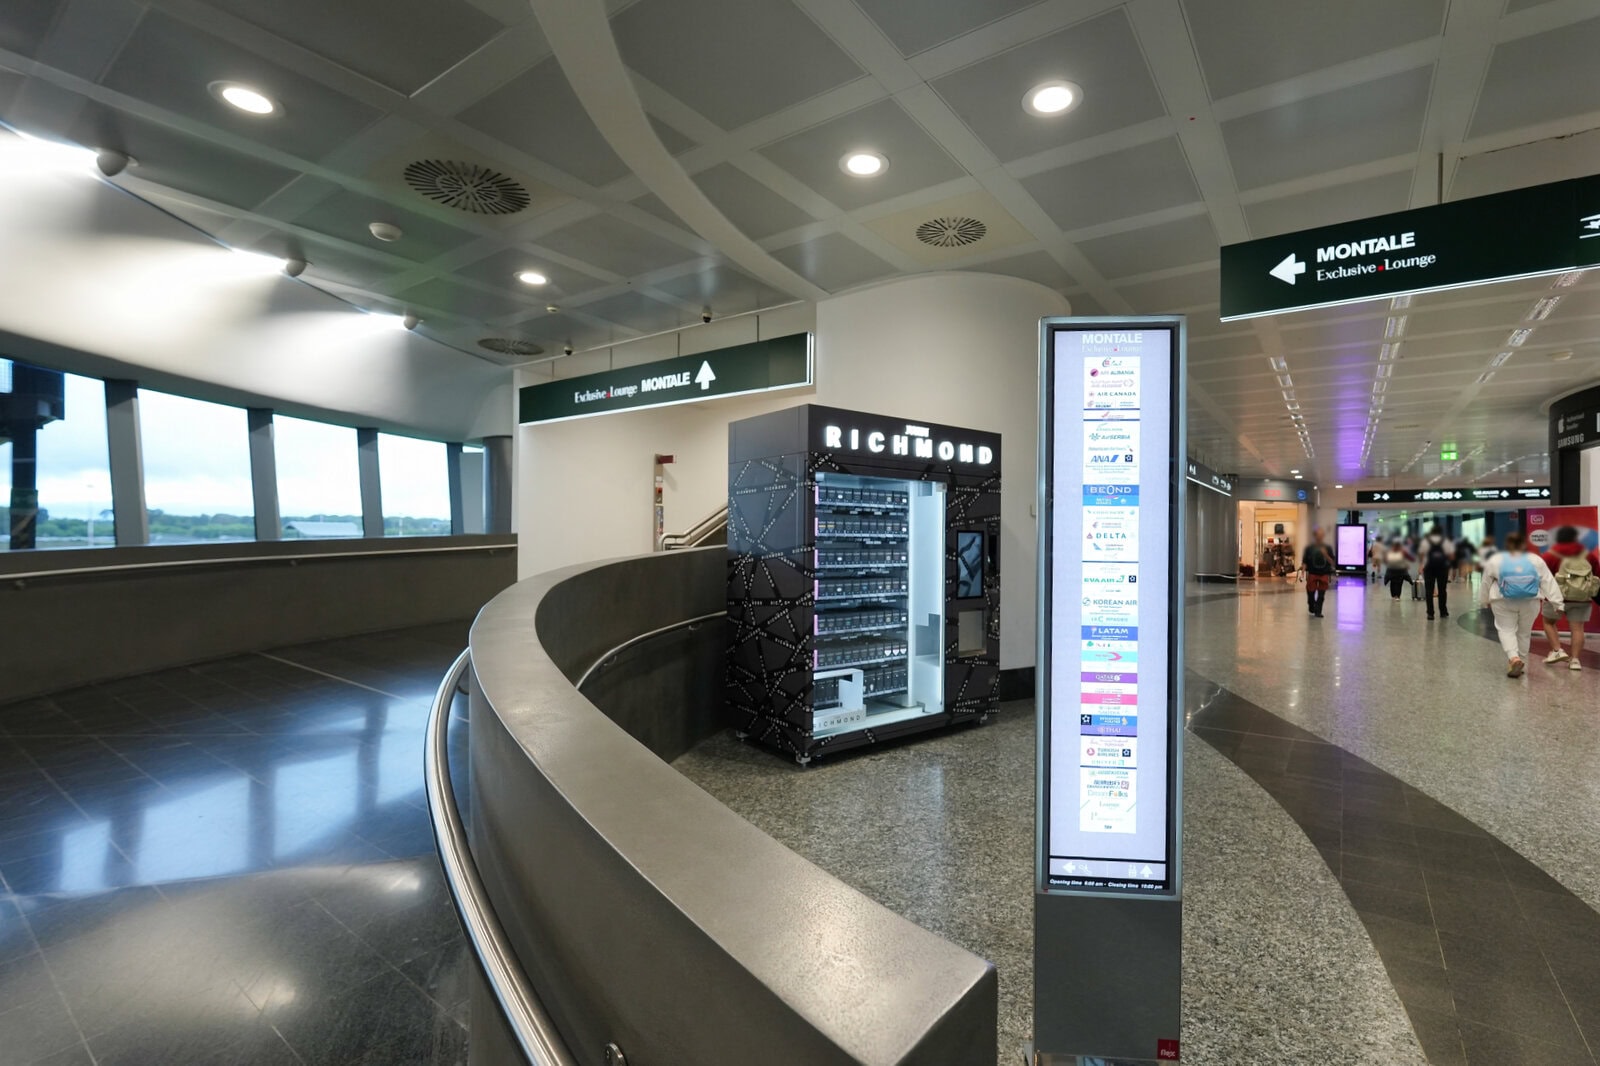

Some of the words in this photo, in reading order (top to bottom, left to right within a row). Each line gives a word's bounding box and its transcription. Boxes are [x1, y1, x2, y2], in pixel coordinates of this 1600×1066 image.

[1316, 232, 1416, 263] MONTALE
[1082, 333, 1143, 344] MONTALE
[641, 371, 691, 393] MONTALE
[825, 425, 993, 465] RICHMOND
[1557, 433, 1585, 449] SAMSUNG
[1090, 455, 1110, 463] ANA
[1049, 878, 1070, 886] Opening
